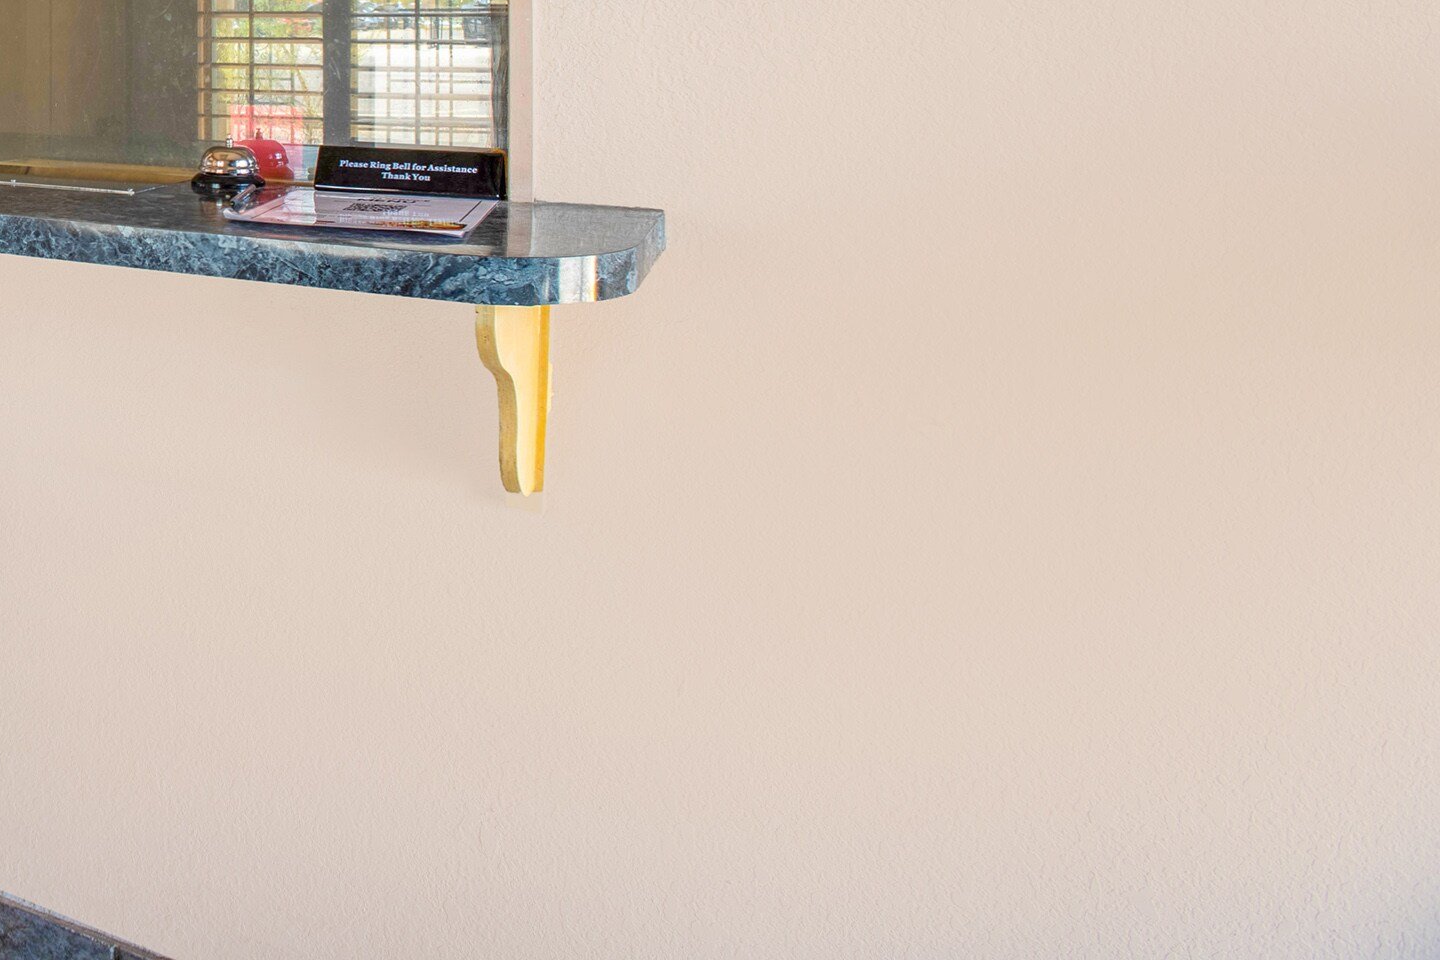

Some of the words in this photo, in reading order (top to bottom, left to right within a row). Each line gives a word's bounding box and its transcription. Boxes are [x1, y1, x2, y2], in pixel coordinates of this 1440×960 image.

[339, 159, 369, 169] Please
[370, 160, 390, 171] Ring
[392, 161, 410, 171] Bell
[411, 162, 426, 171] for
[427, 163, 478, 174] Assistance
[381, 171, 409, 181] Thank
[410, 172, 431, 182] You
